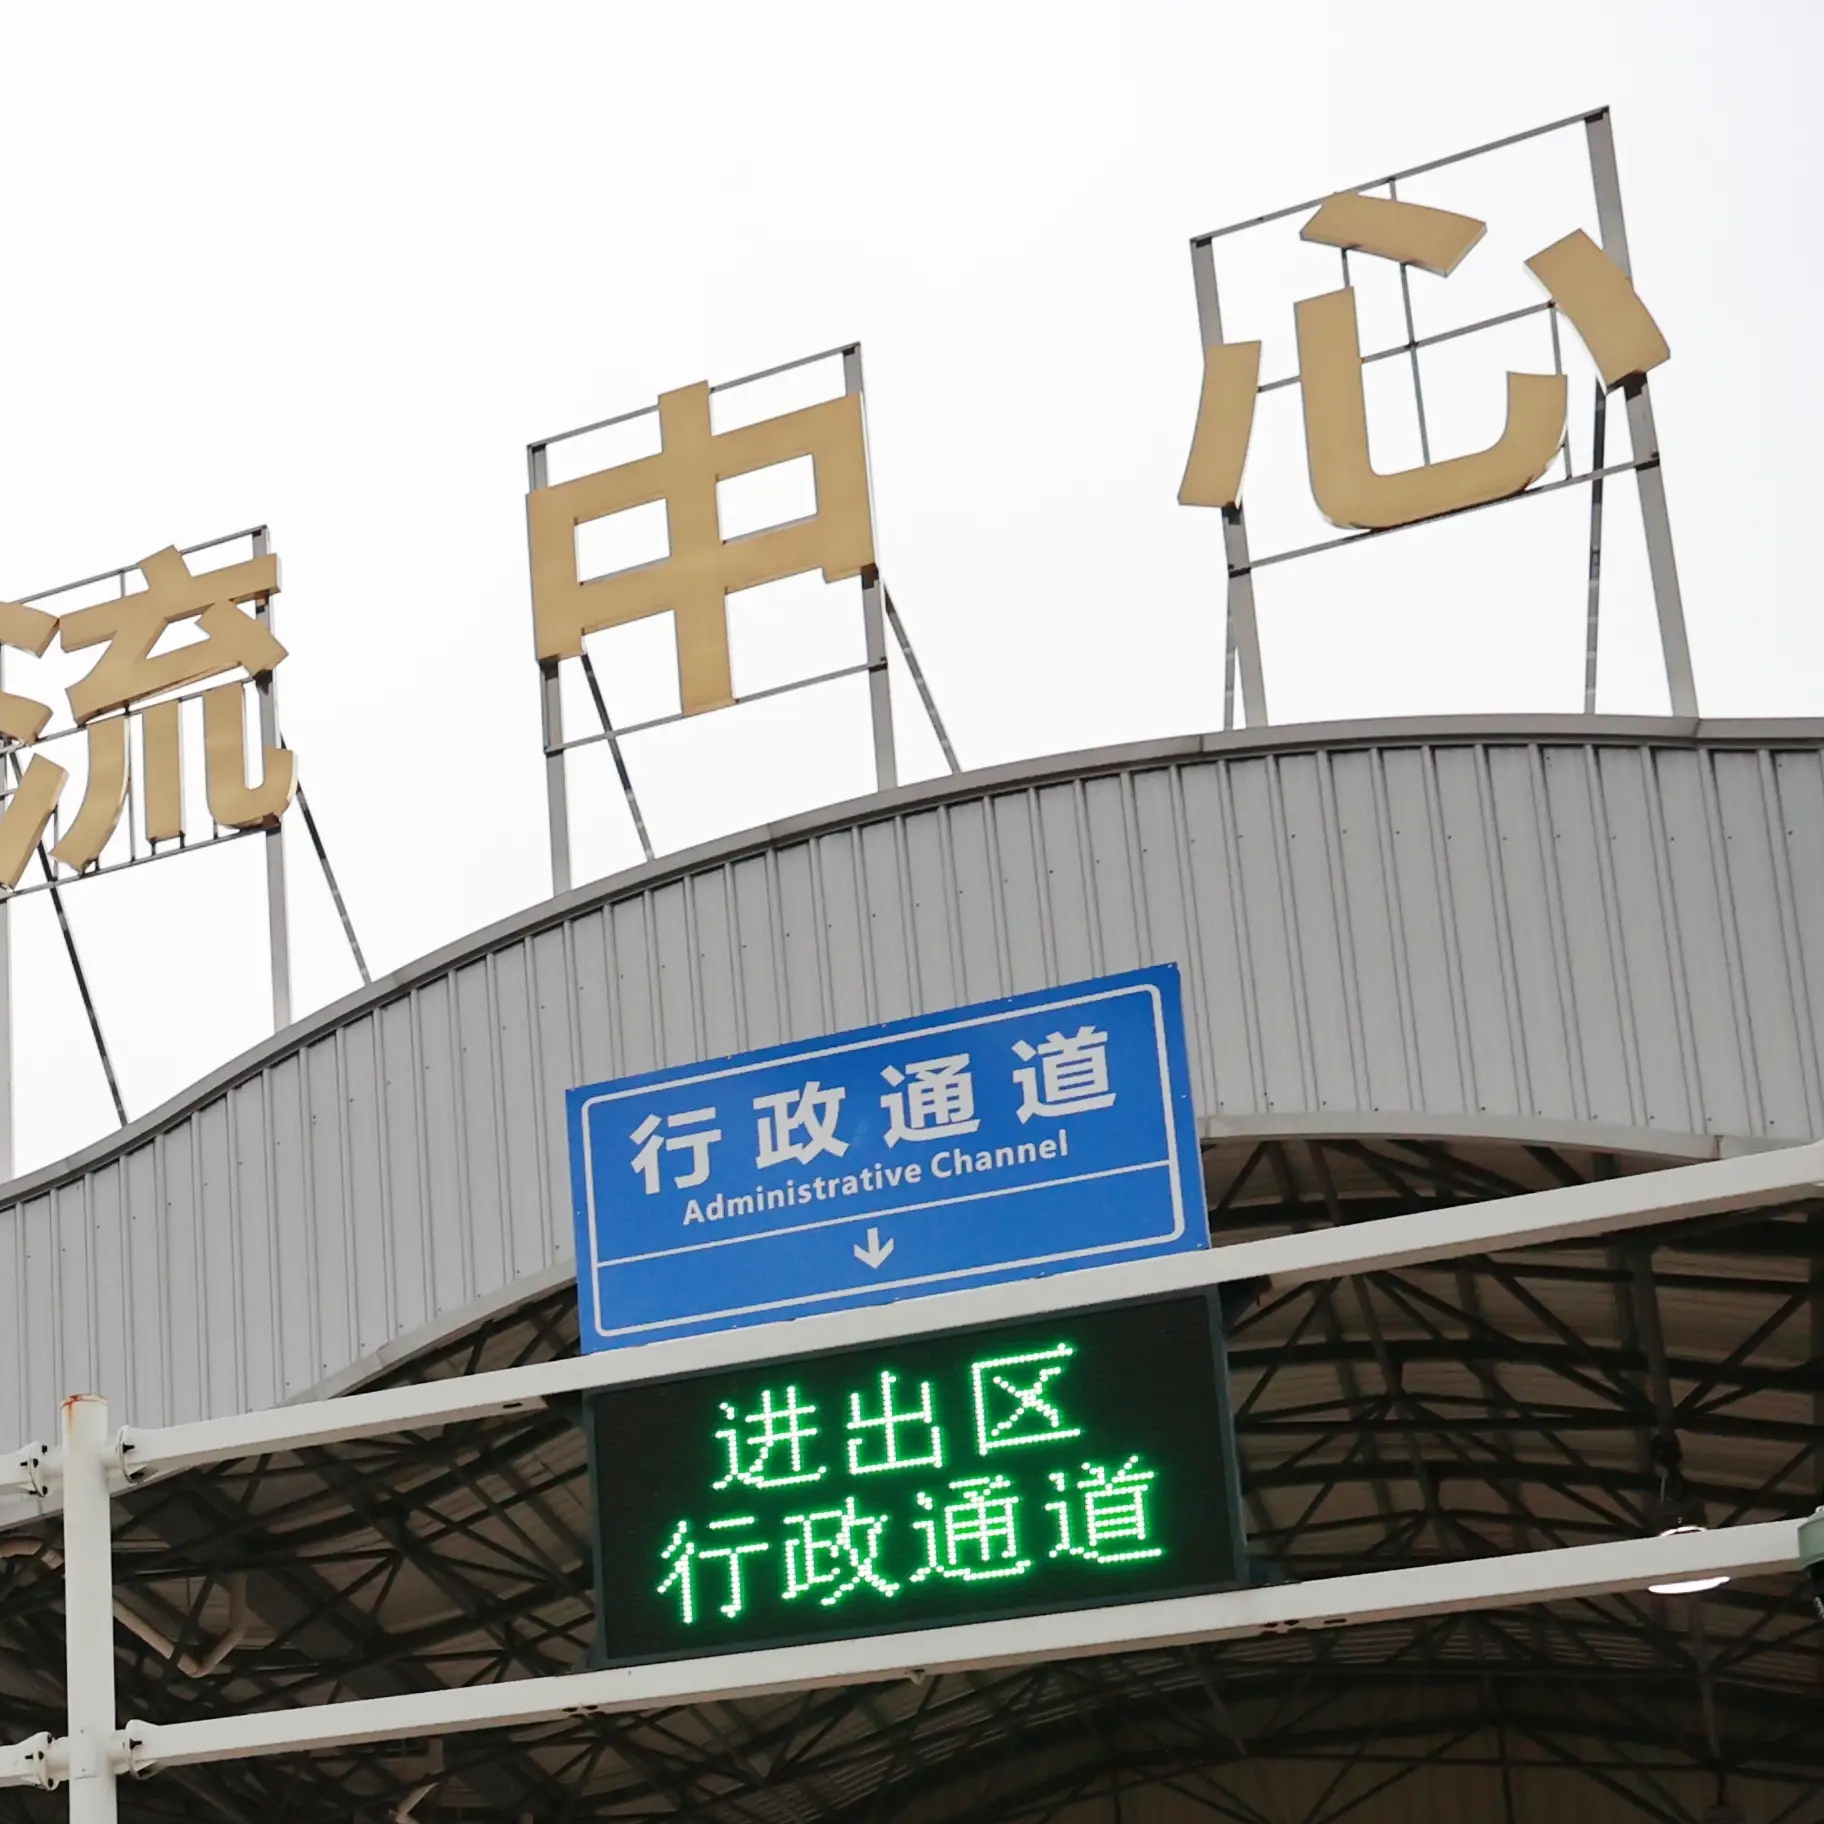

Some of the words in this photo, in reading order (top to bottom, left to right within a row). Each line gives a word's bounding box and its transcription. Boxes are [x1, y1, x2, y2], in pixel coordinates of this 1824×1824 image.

[630, 1026, 1116, 1194] 行政通道
[683, 1161, 922, 1226] Administrative
[931, 1130, 1068, 1180] Channel
[713, 1343, 1080, 1489] 进出区
[657, 1455, 1162, 1624] 行政通道
